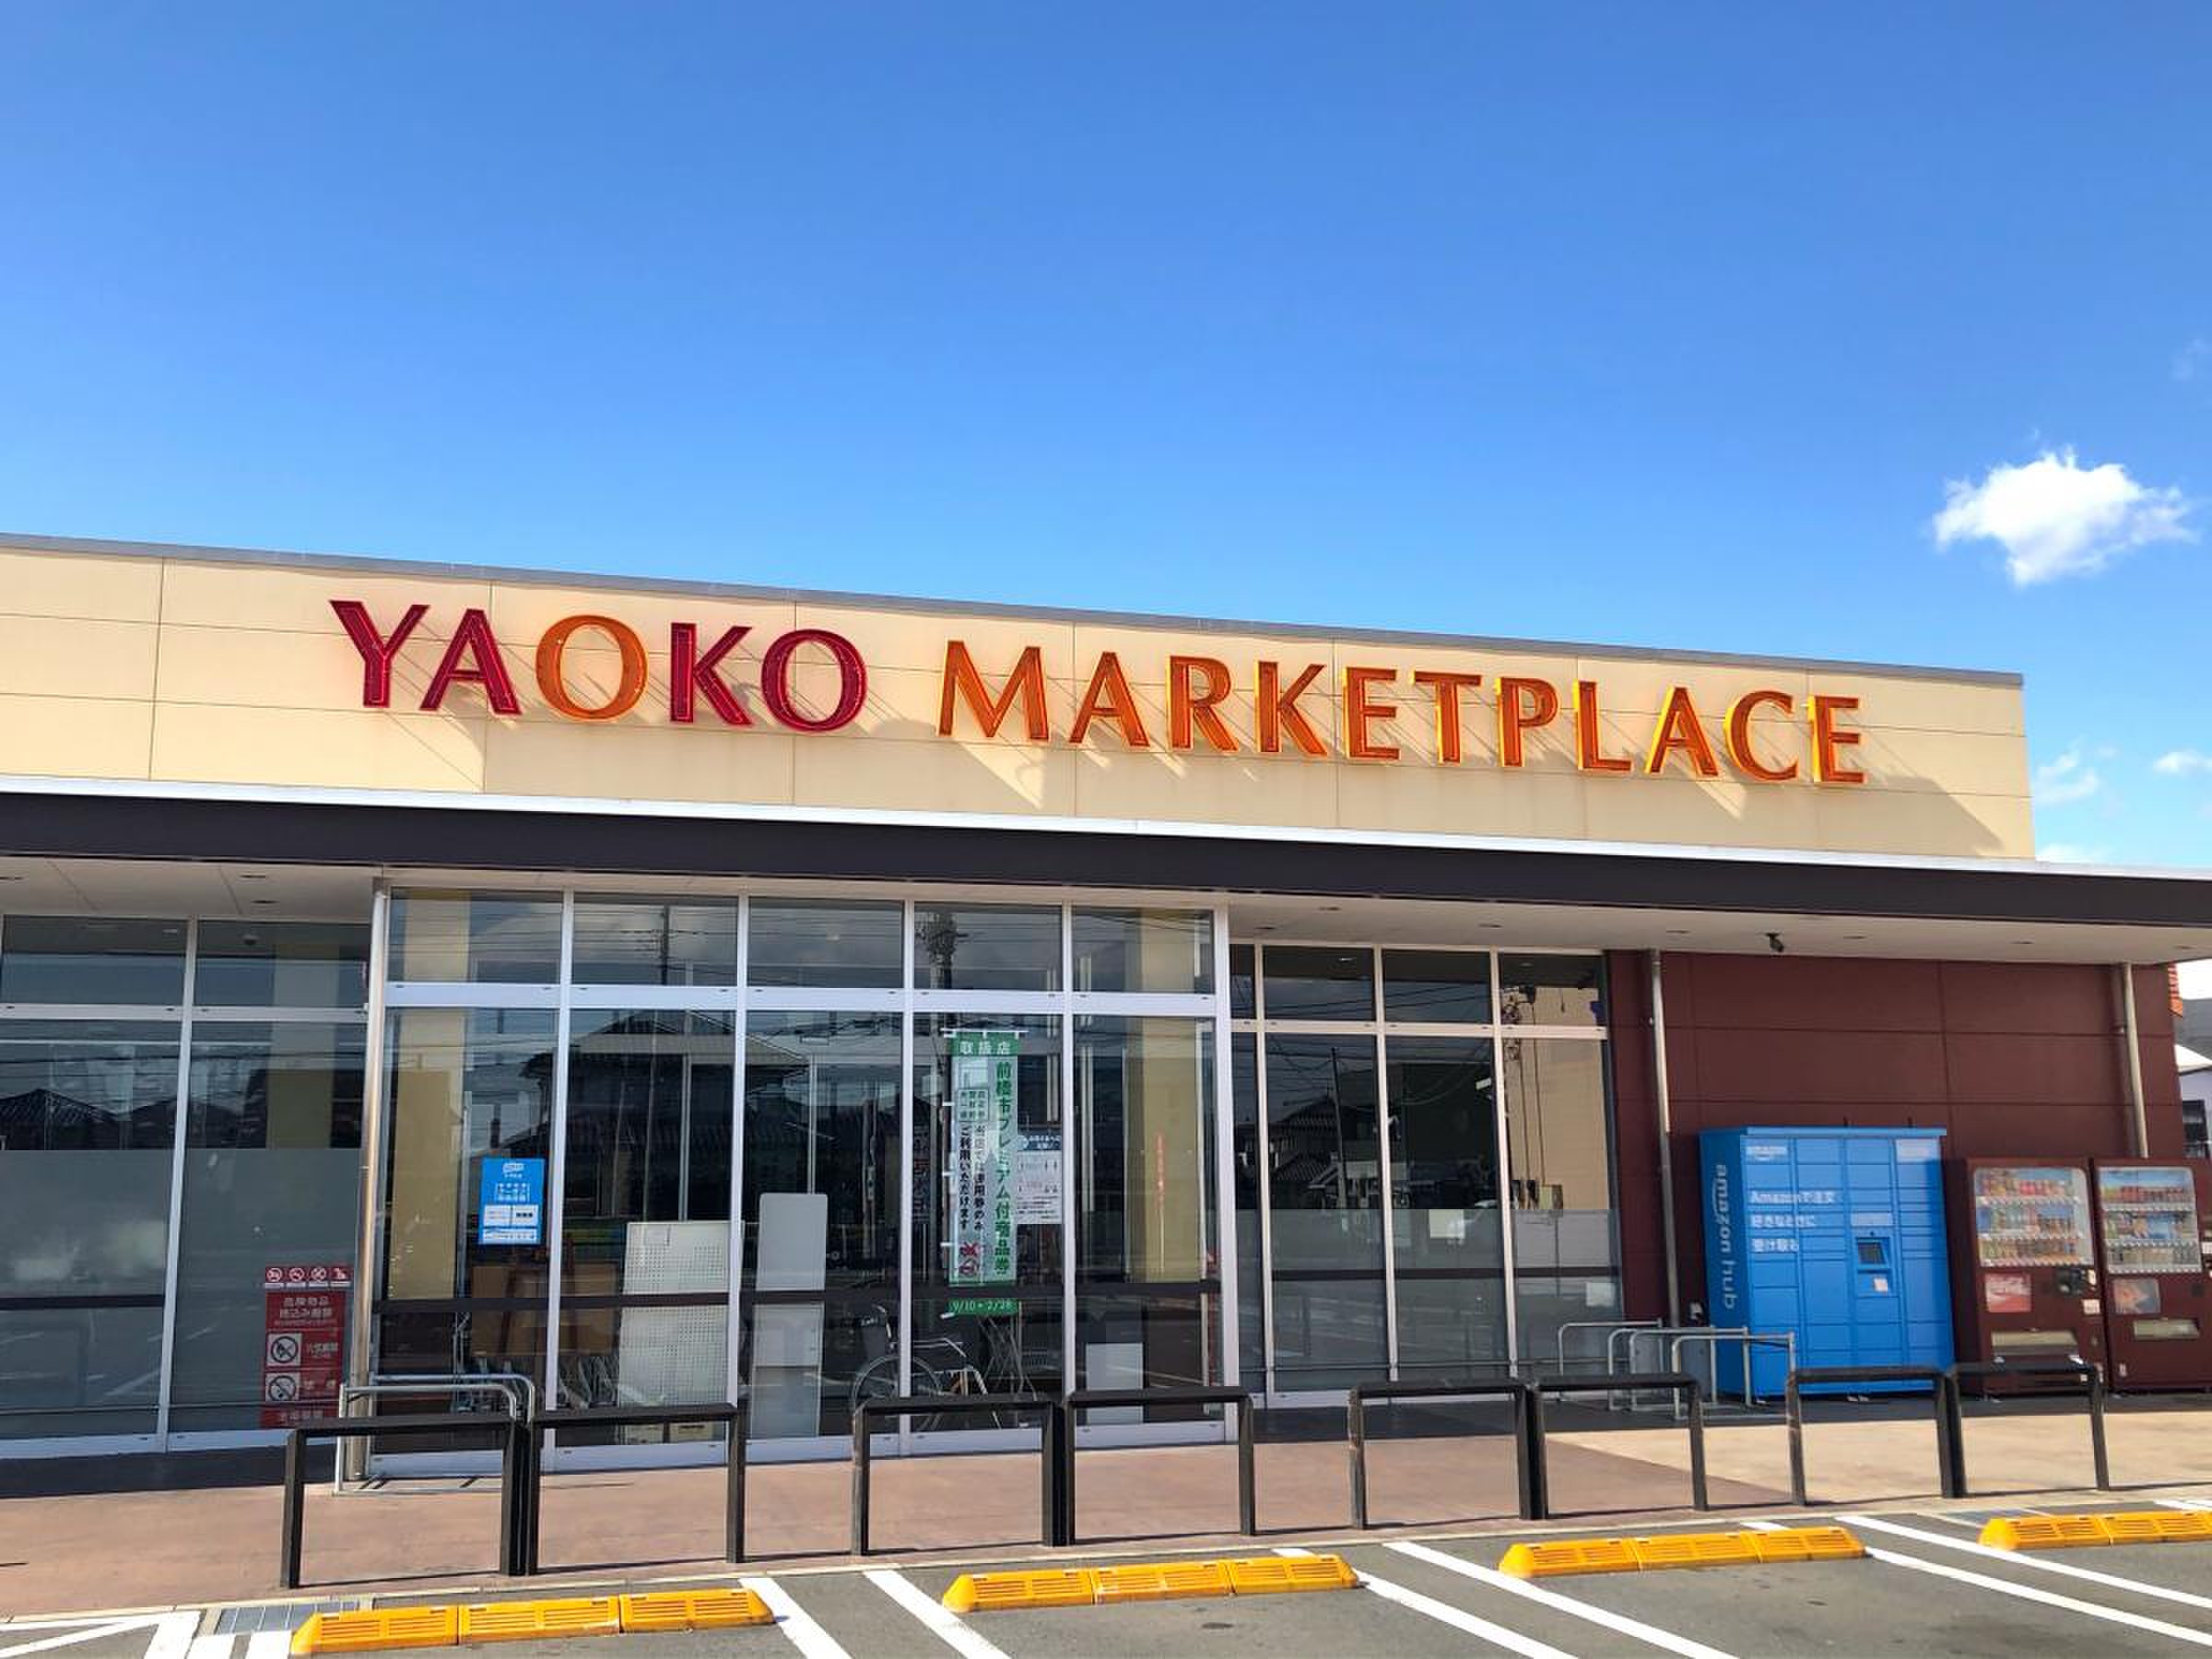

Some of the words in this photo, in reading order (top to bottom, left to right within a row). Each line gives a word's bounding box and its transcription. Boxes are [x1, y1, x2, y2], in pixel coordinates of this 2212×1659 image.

[329, 600, 867, 732] YAOKO
[938, 639, 1867, 784] MARKETPLACE
[1714, 1165, 1732, 1253] amazon
[1722, 1259, 1738, 1310] hub
